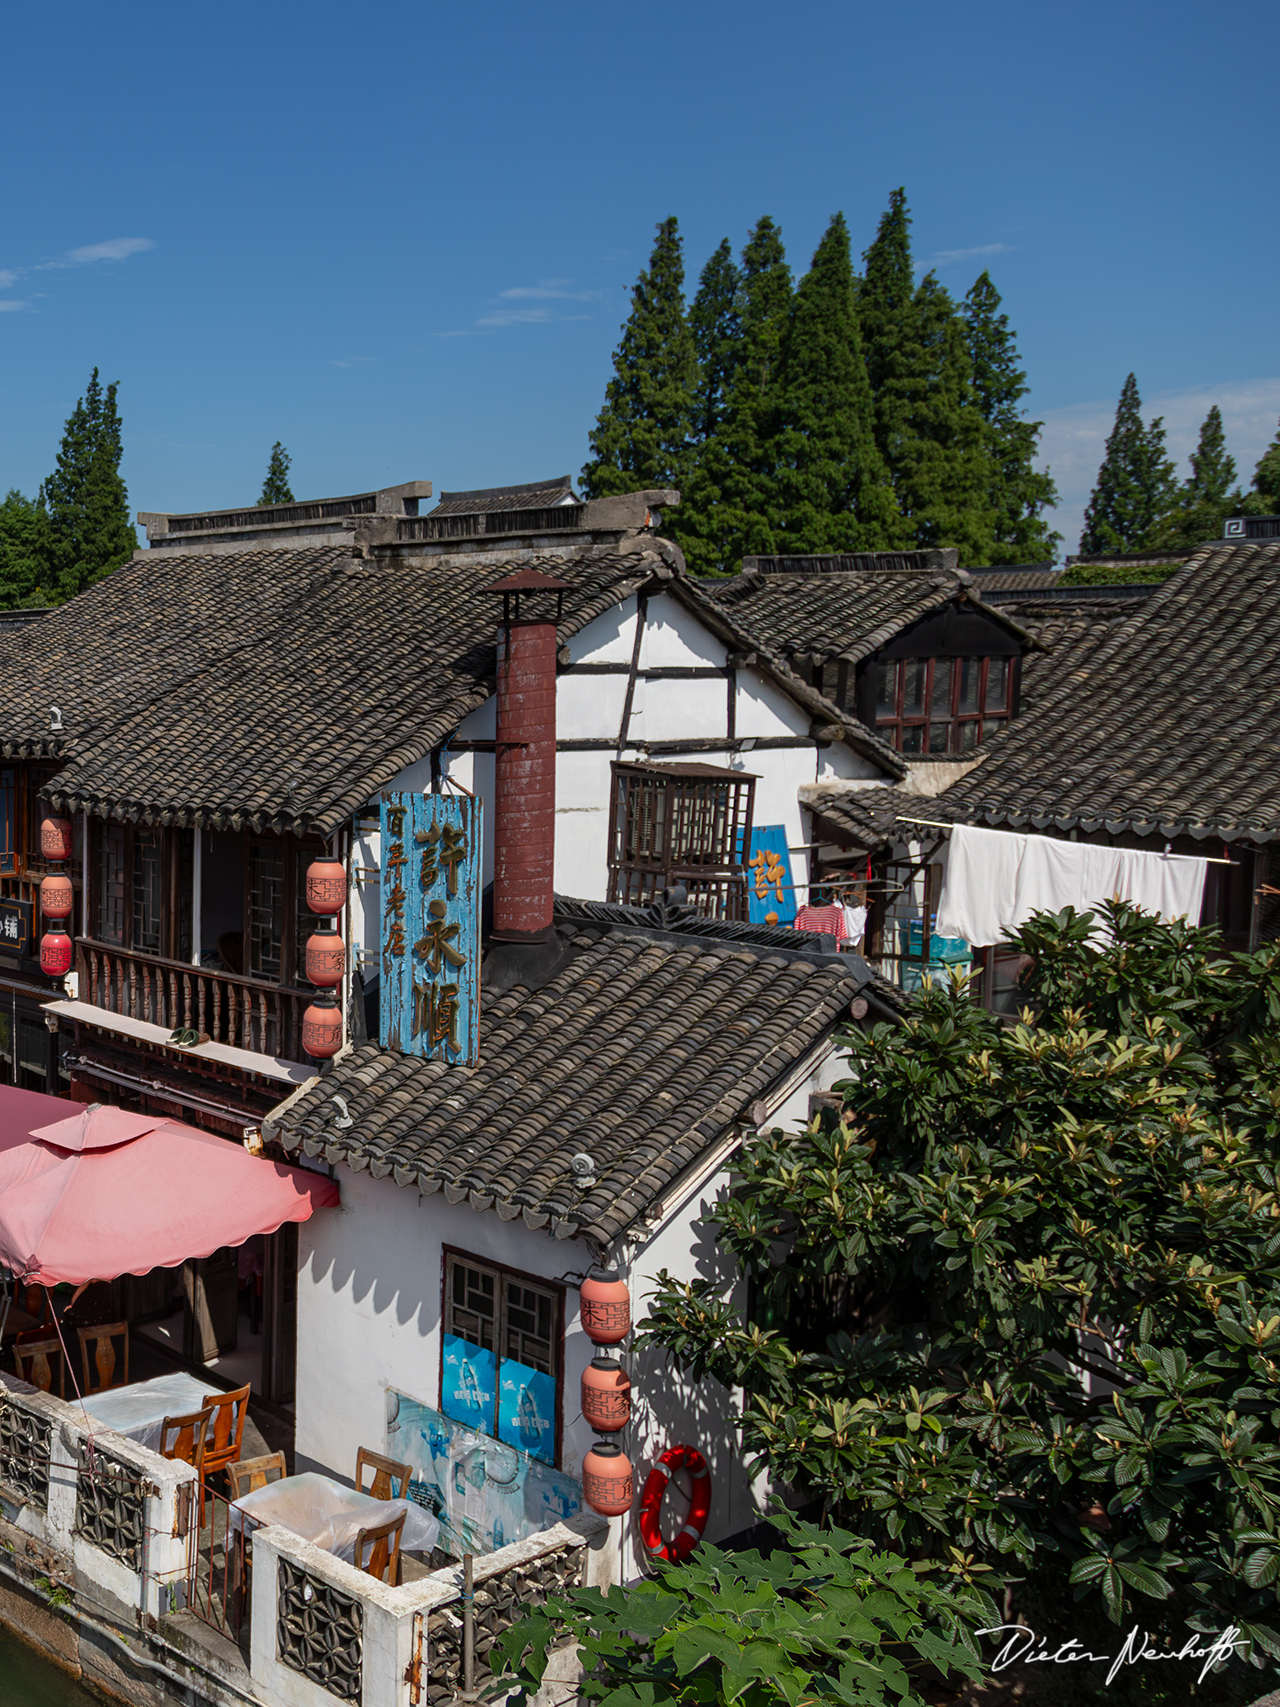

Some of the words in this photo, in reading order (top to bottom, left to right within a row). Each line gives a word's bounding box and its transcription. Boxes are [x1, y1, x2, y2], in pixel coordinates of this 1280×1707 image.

[385, 806, 409, 956] 百年老店
[414, 821, 467, 1054] 許永順
[748, 849, 786, 926] 許
[583, 1301, 607, 1324] 朱
